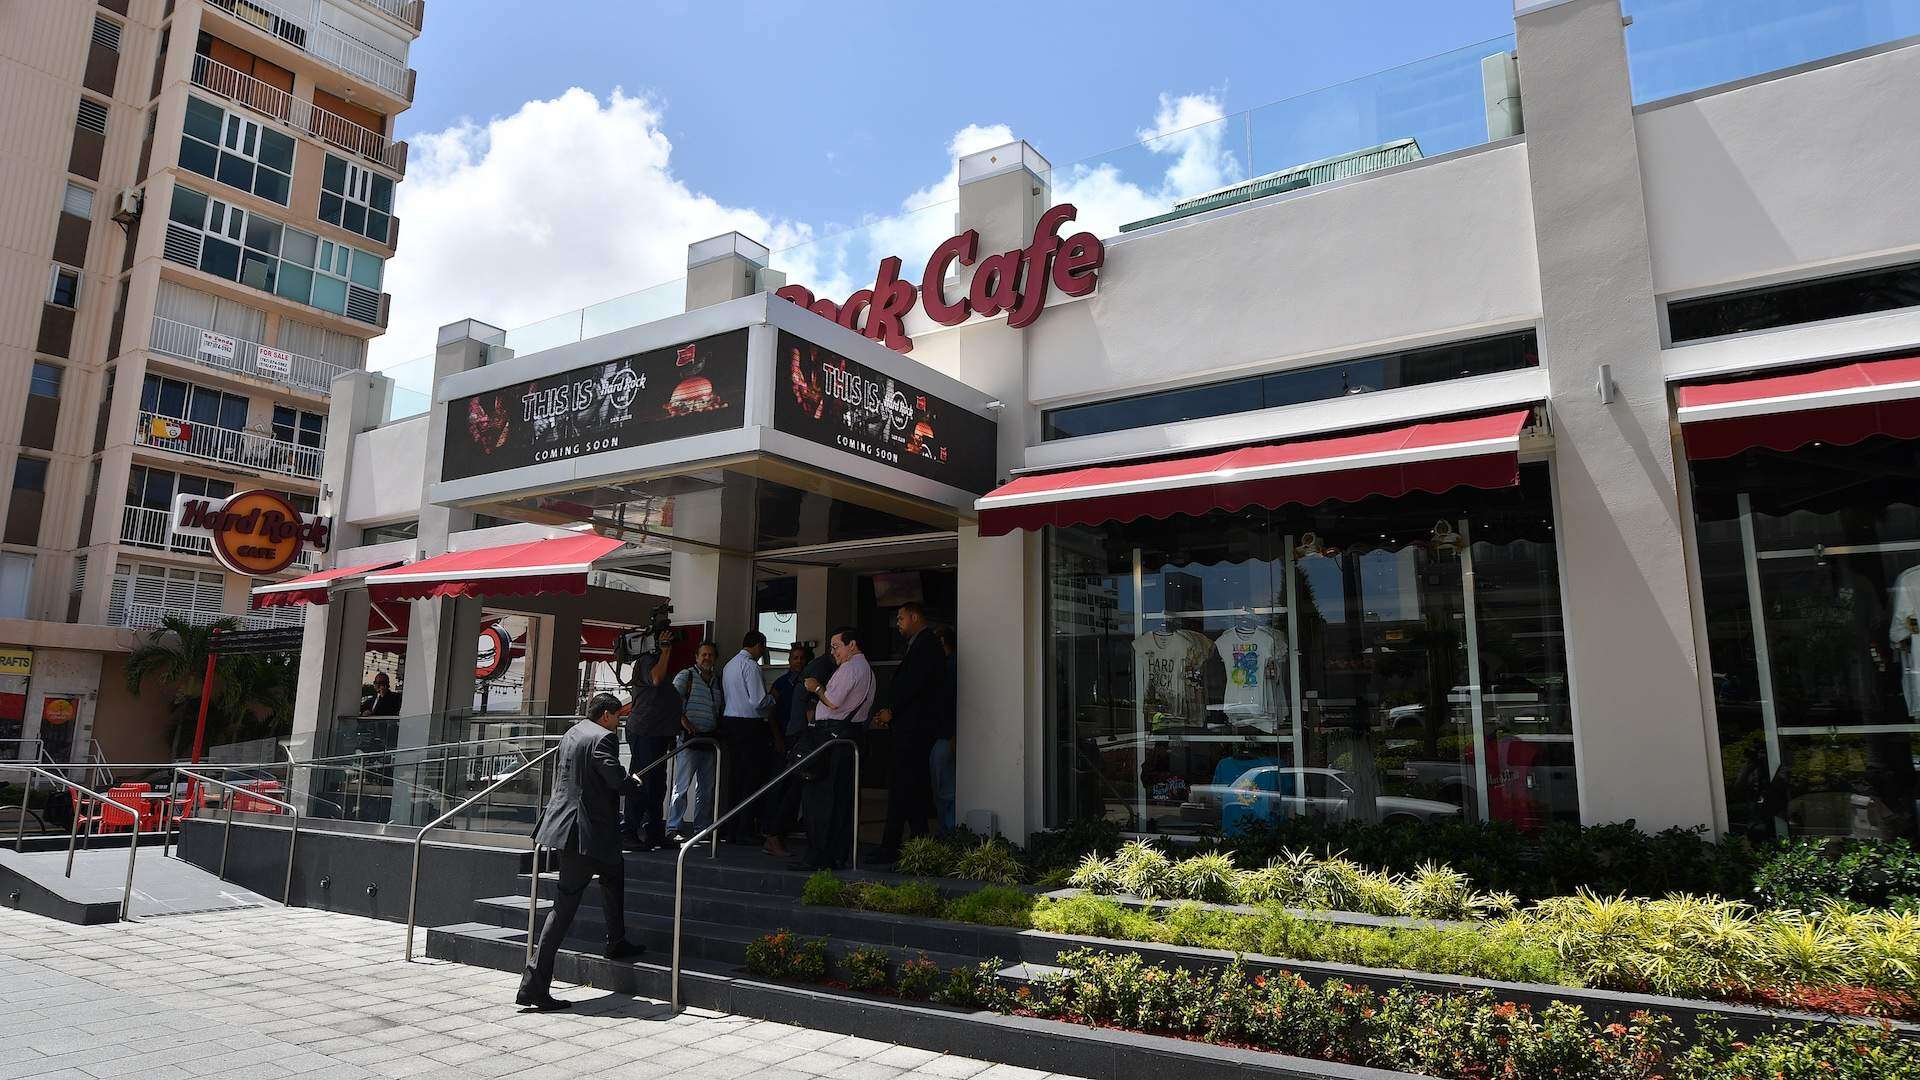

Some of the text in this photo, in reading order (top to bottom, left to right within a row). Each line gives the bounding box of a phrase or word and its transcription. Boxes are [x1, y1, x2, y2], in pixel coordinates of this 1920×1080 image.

[775, 203, 1104, 353] ck Cafe
[259, 348, 289, 361] FOR SALE
[600, 373, 647, 396] Hard Rock
[823, 363, 880, 413] THIS IS
[522, 379, 593, 422] THIS IS
[534, 437, 619, 461] COMING SOON
[837, 434, 898, 463] COMING SOON
[179, 499, 328, 549] Hard Rock
[236, 545, 277, 560] CAFE
[1148, 658, 1175, 673] HARD
